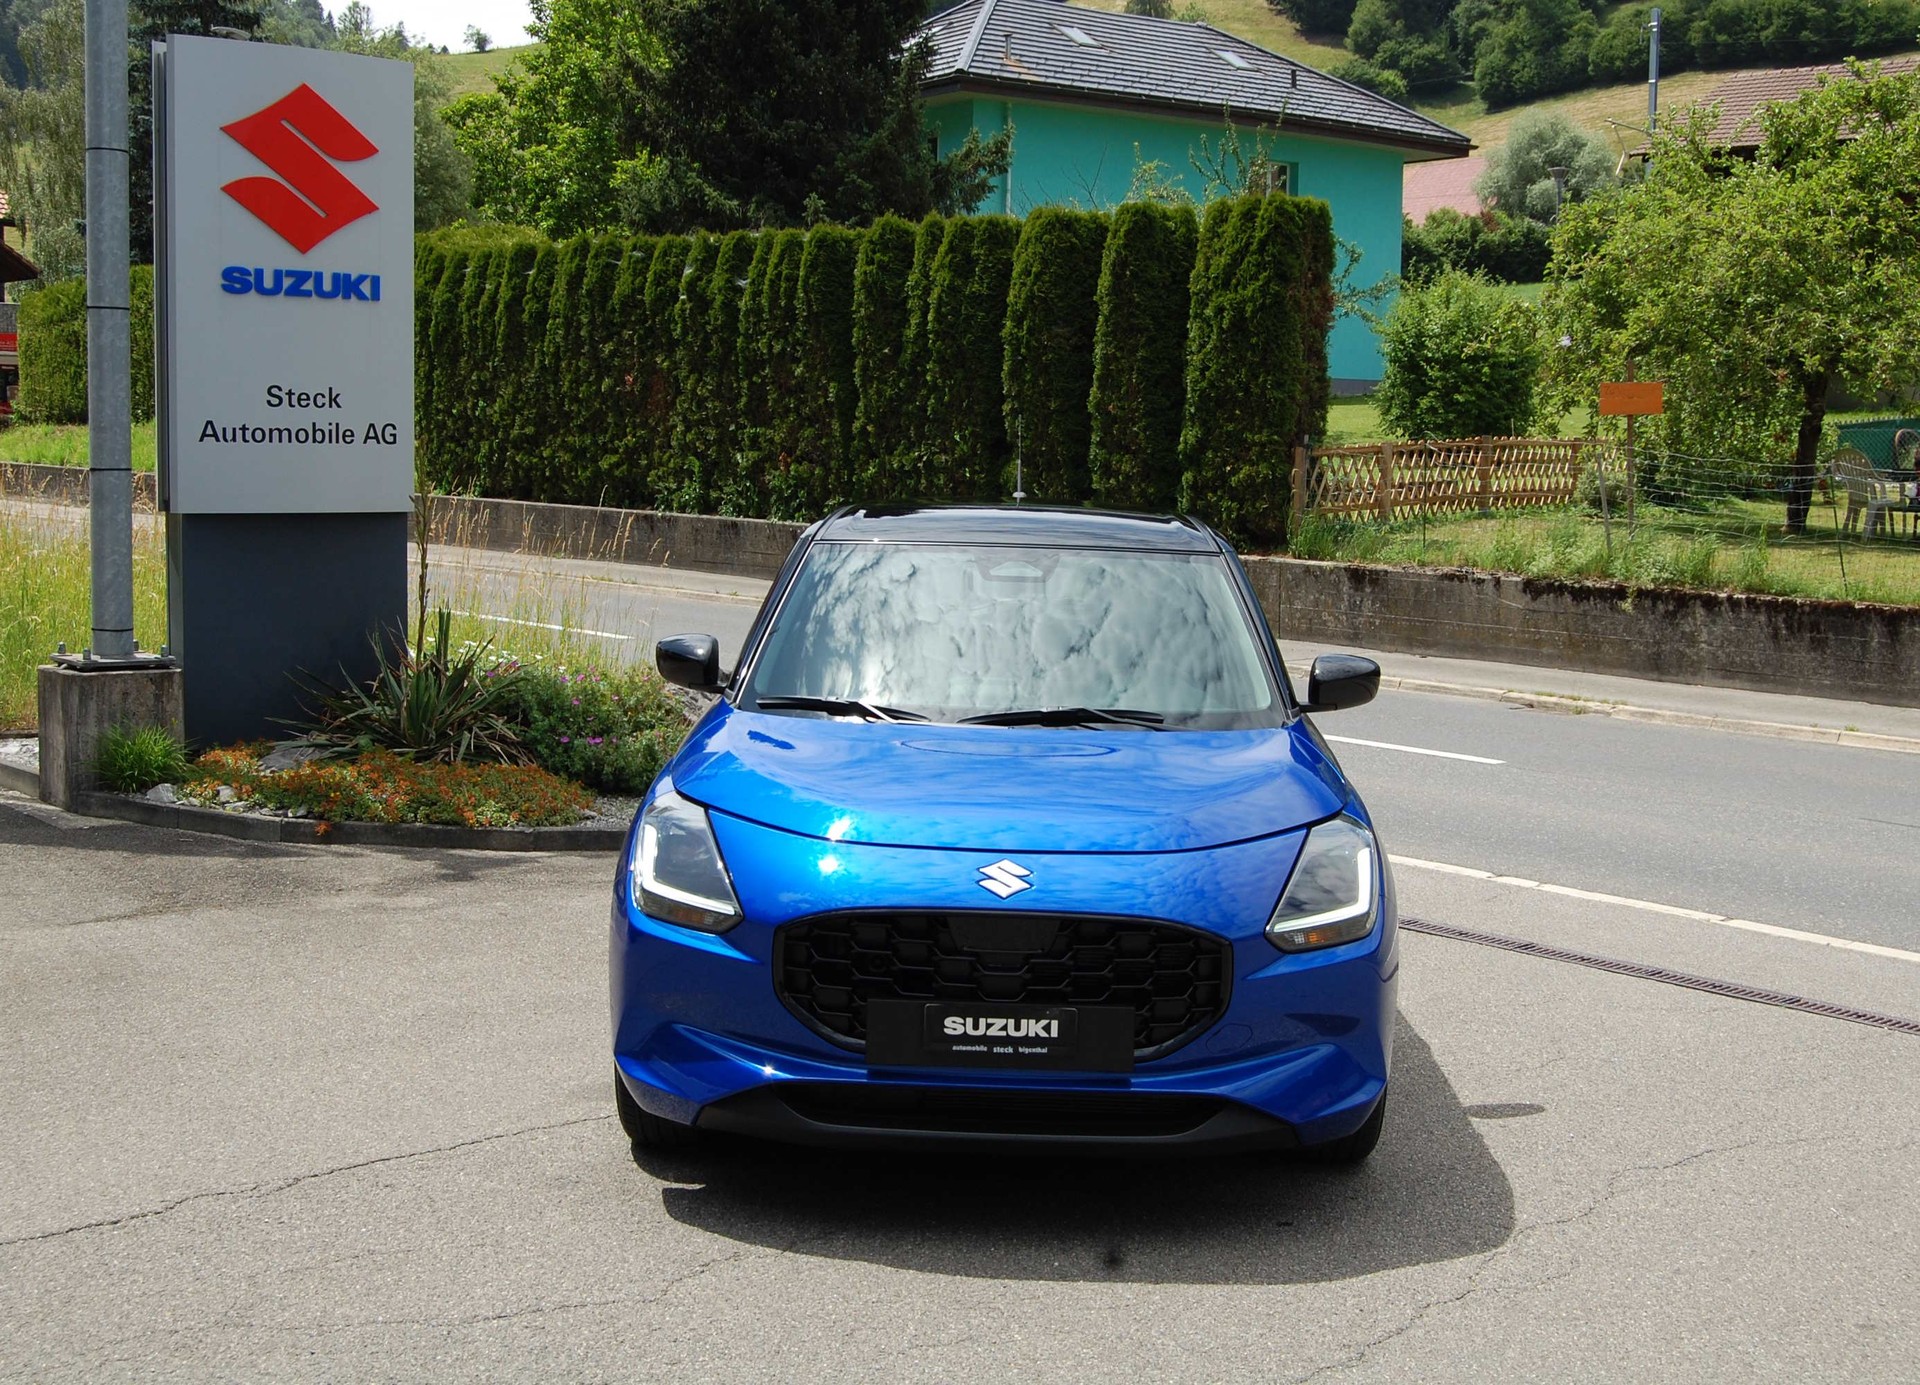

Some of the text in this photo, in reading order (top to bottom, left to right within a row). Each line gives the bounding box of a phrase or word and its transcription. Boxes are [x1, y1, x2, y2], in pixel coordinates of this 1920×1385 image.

[221, 266, 381, 301] SUZUKI
[266, 385, 342, 409] Steck
[198, 420, 398, 445] Automobile AG
[943, 1016, 1059, 1038] SUZUKI
[993, 1046, 1014, 1054] steck
